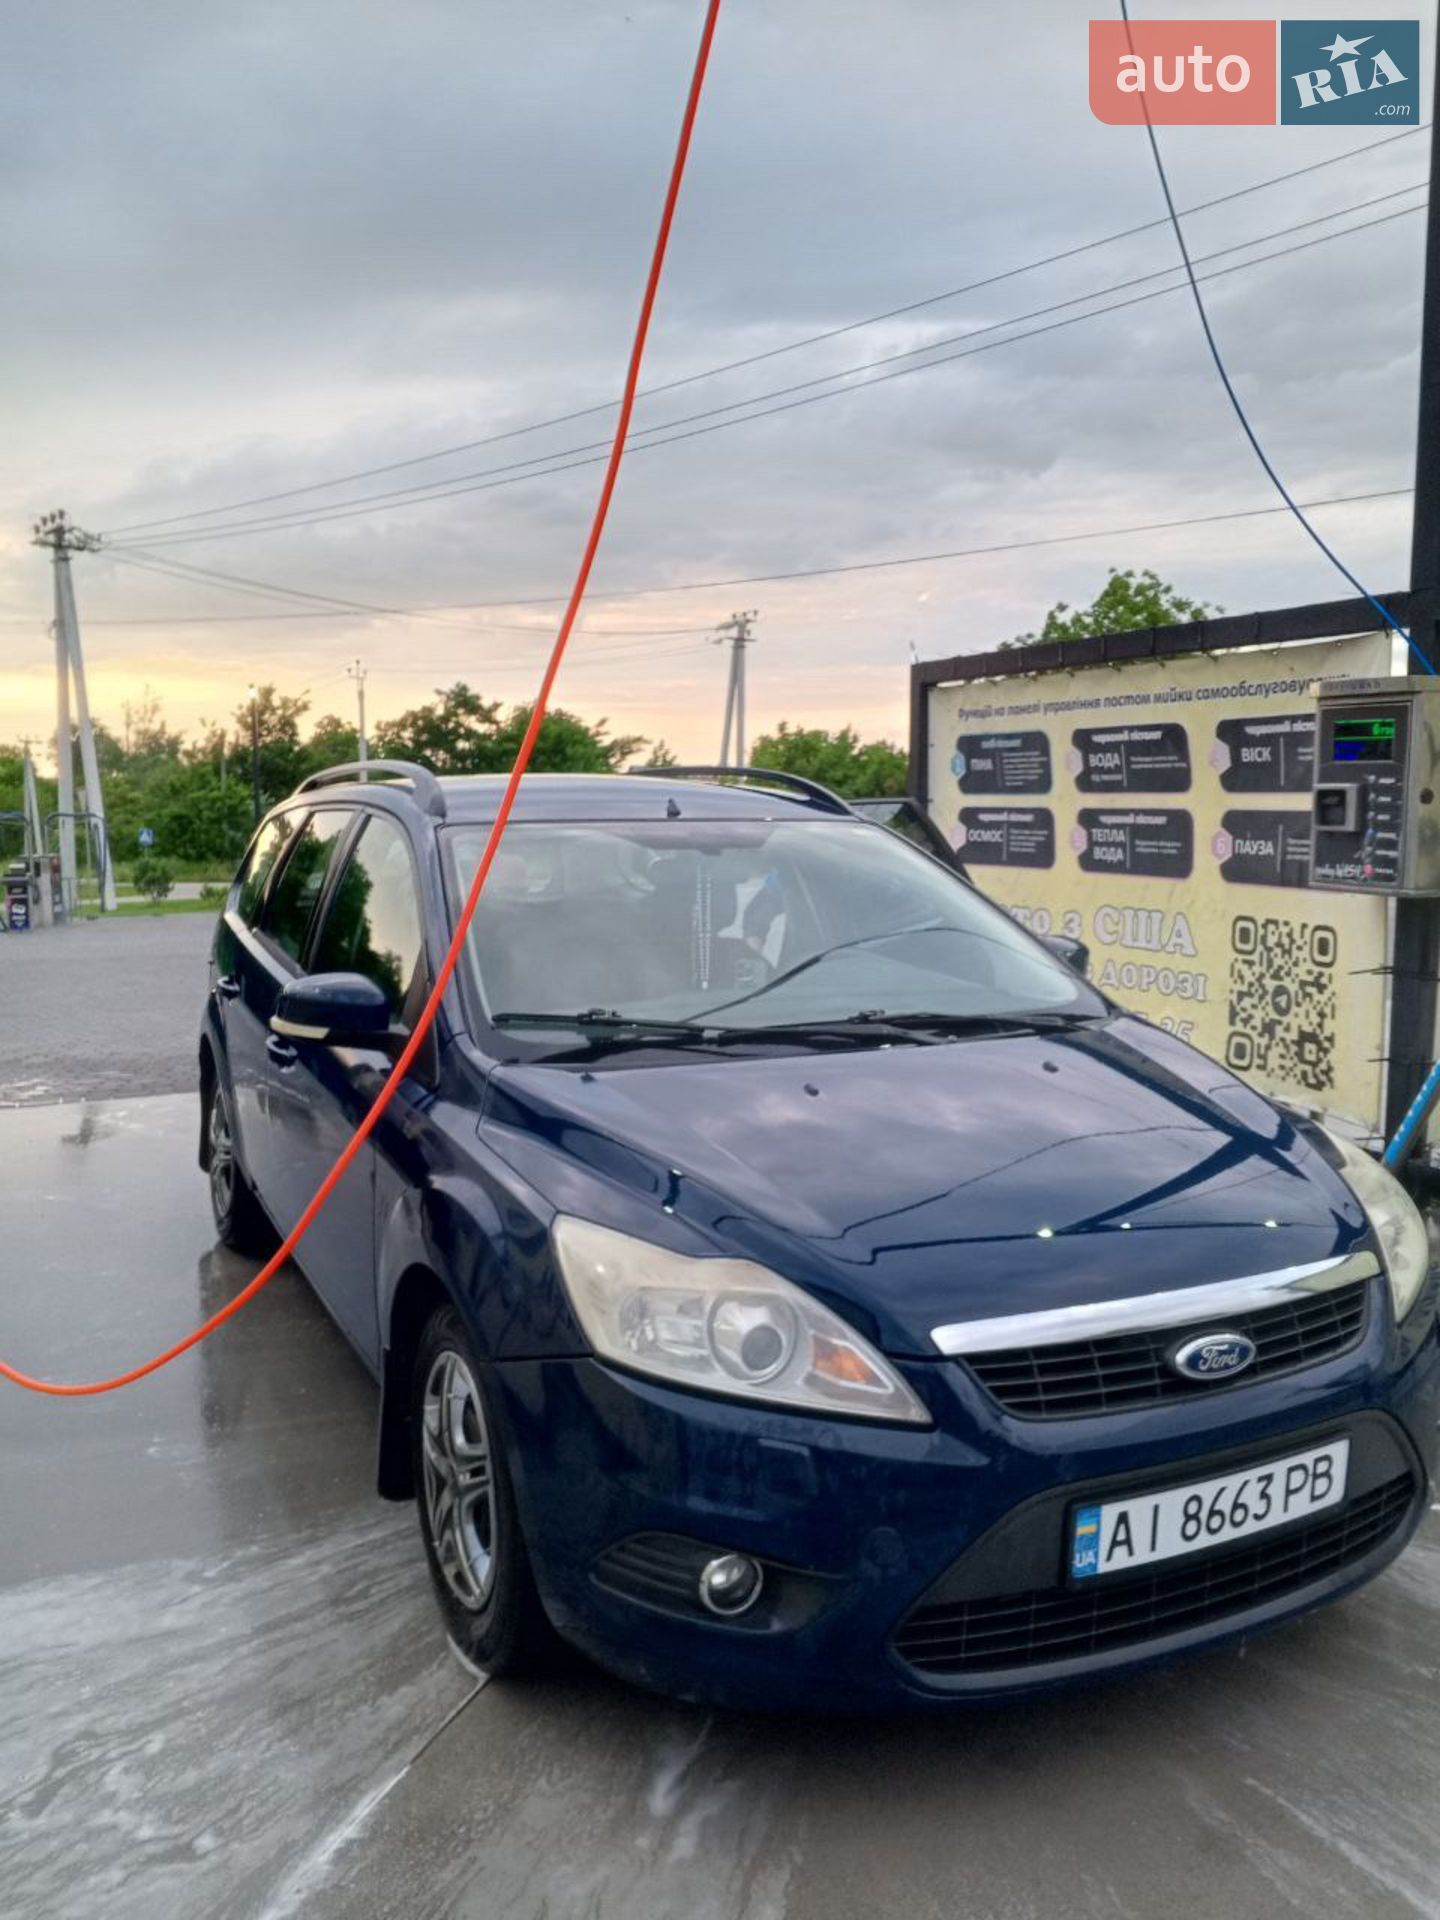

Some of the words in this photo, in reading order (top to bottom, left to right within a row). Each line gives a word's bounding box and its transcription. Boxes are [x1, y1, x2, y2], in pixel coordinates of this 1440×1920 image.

[1043, 696, 1101, 715] управління
[1103, 691, 1150, 709] постом
[1153, 686, 1193, 704] мийки
[1197, 674, 1349, 700] самообслугову
[1088, 752, 1121, 769] ВОДА
[1241, 747, 1271, 762] ВІСК
[1091, 827, 1126, 843] ТЕПЛА
[1093, 846, 1124, 863] ВОДА
[1235, 839, 1274, 855] ПАУЗА
[1093, 904, 1199, 957] США
[1100, 959, 1208, 1003] ДОРОЗІ
[1198, 1343, 1241, 1371] Ford
[1105, 1504, 1160, 1562] AI
[1180, 1471, 1275, 1542] 8663
[1283, 1453, 1334, 1514] PB
[1073, 1549, 1097, 1568] UA
